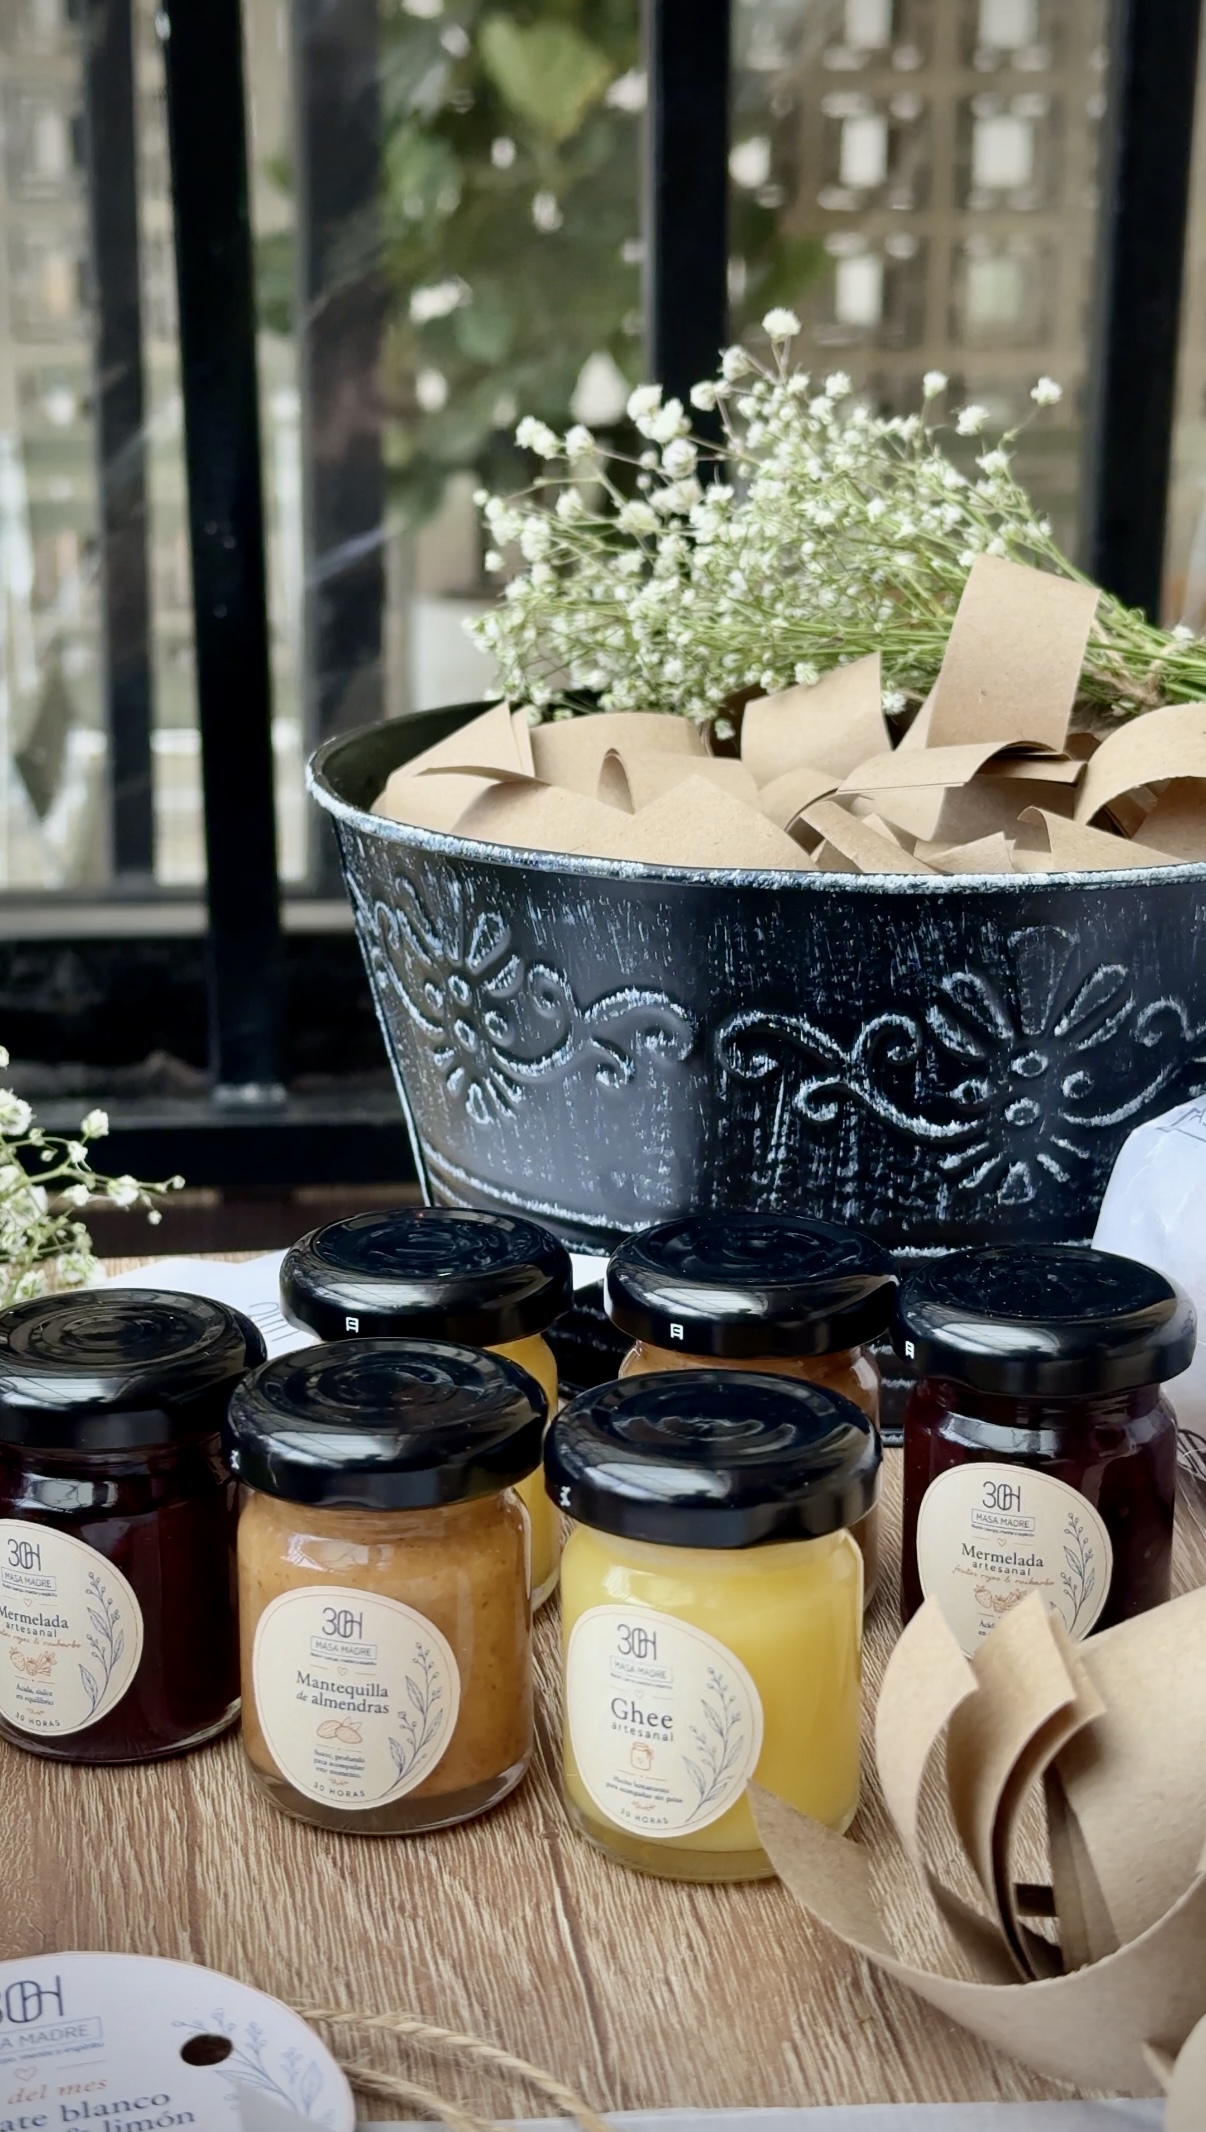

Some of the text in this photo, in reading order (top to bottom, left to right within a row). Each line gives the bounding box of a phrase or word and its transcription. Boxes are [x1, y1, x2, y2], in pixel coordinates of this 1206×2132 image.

[976, 1513, 1031, 1529] MASA MADRE
[961, 1543, 1045, 1568] Mermelada
[972, 1561, 1031, 1577] artesanal
[5, 1572, 52, 1588] MASA MADRE
[0, 1605, 69, 1629] Mermelada
[6, 1621, 57, 1638] artesanal
[315, 1641, 372, 1657] MASA MADRE
[615, 1660, 667, 1679] MASA MADRE
[296, 1670, 389, 1700] Mantequilla
[296, 1690, 389, 1714] de almendras
[29, 1718, 60, 1727] HORAS
[611, 1697, 673, 1730] Ghee
[611, 1721, 674, 1742] artesanal
[313, 1781, 365, 1798] 30 HORAS
[635, 1814, 669, 1825] HORAS
[19, 2023, 91, 2047] MADRE
[8, 2079, 108, 2104] del mes
[60, 2093, 170, 2122] blanco
[103, 2110, 195, 2132] limón
